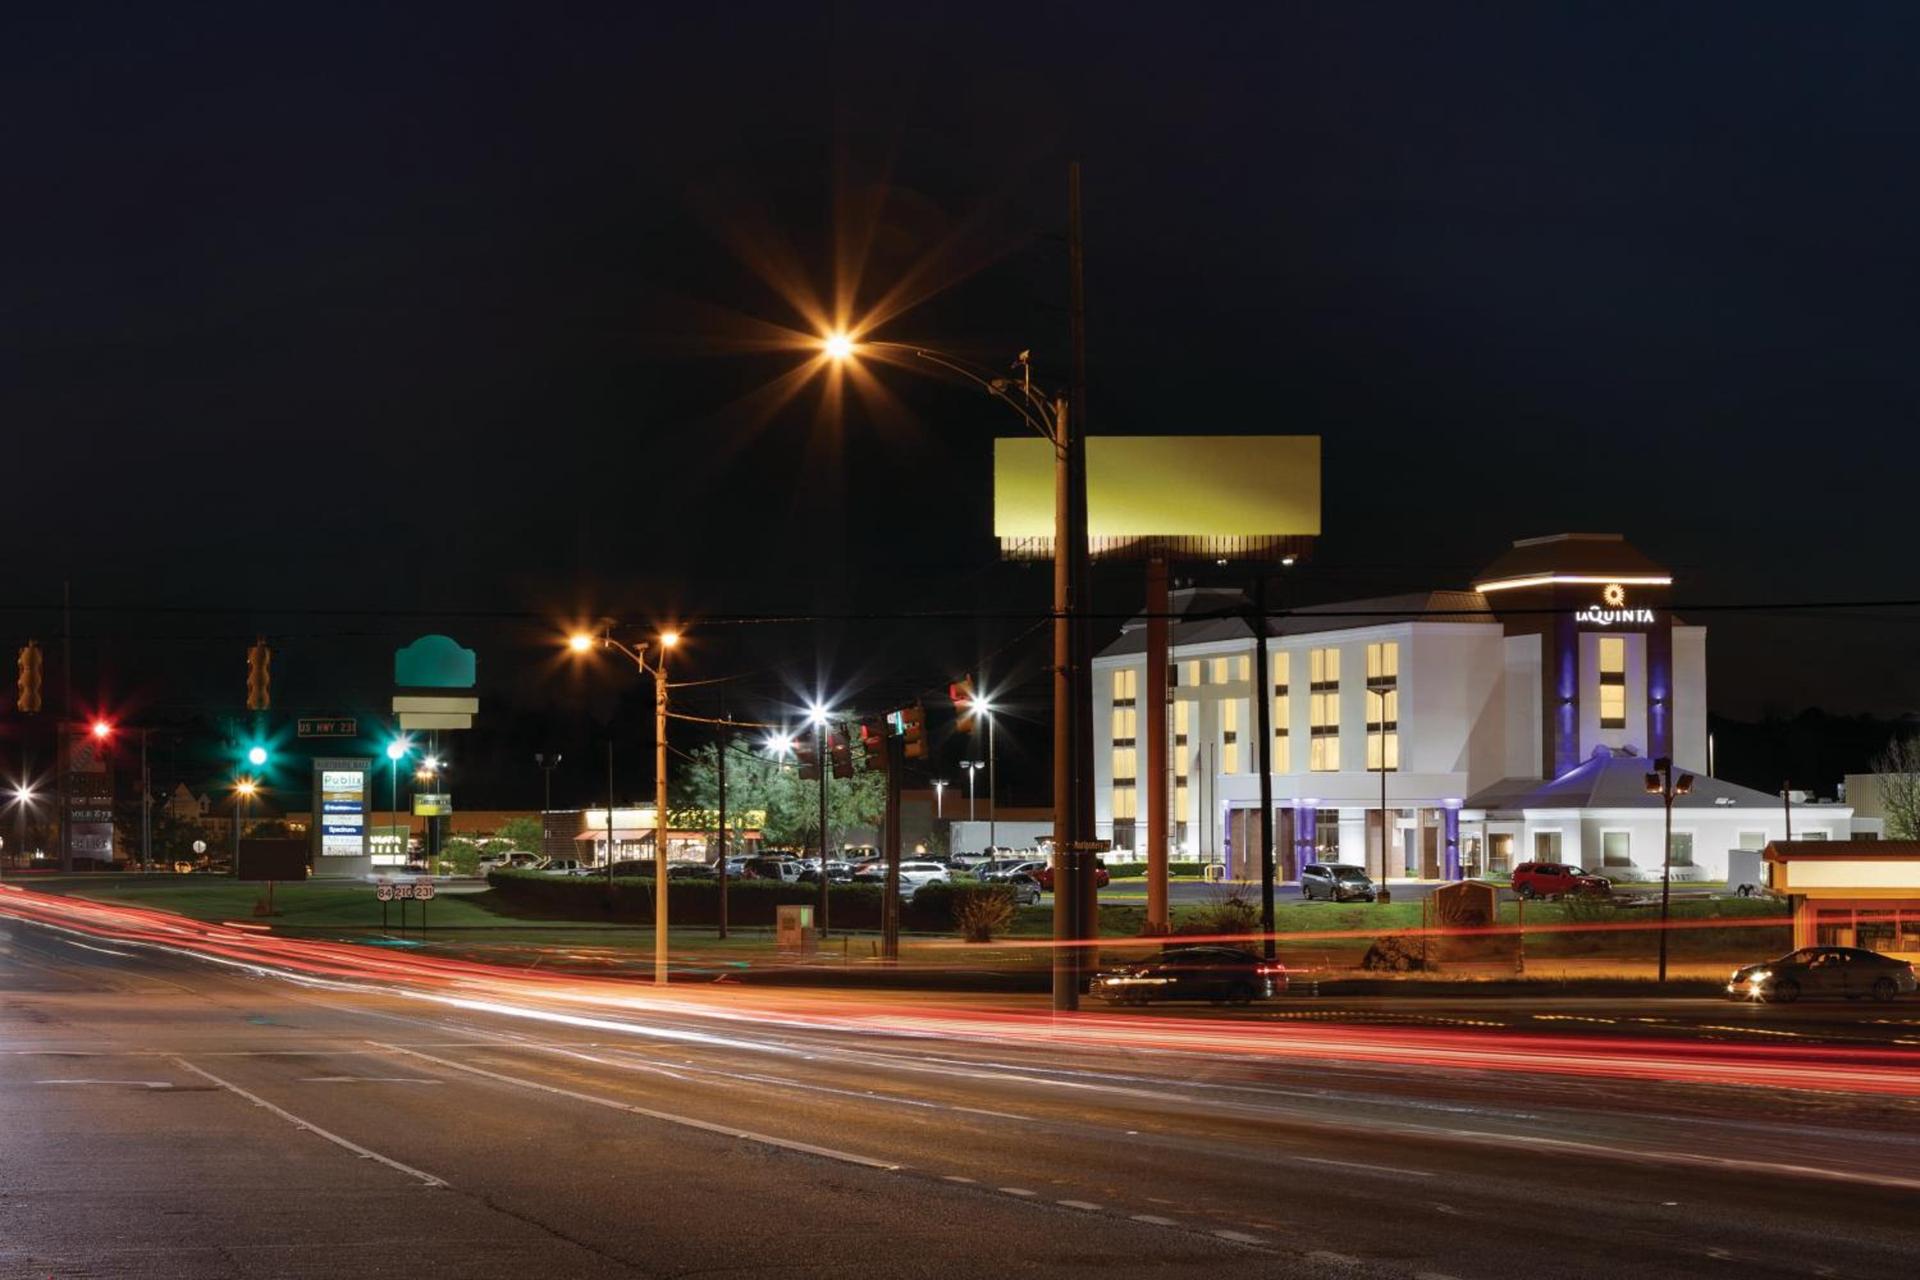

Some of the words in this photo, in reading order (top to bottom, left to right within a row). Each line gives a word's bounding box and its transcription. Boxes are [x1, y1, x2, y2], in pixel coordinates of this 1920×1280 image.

[324, 775, 362, 785] Publix
[378, 888, 392, 898] 84
[416, 887, 432, 897] 231
